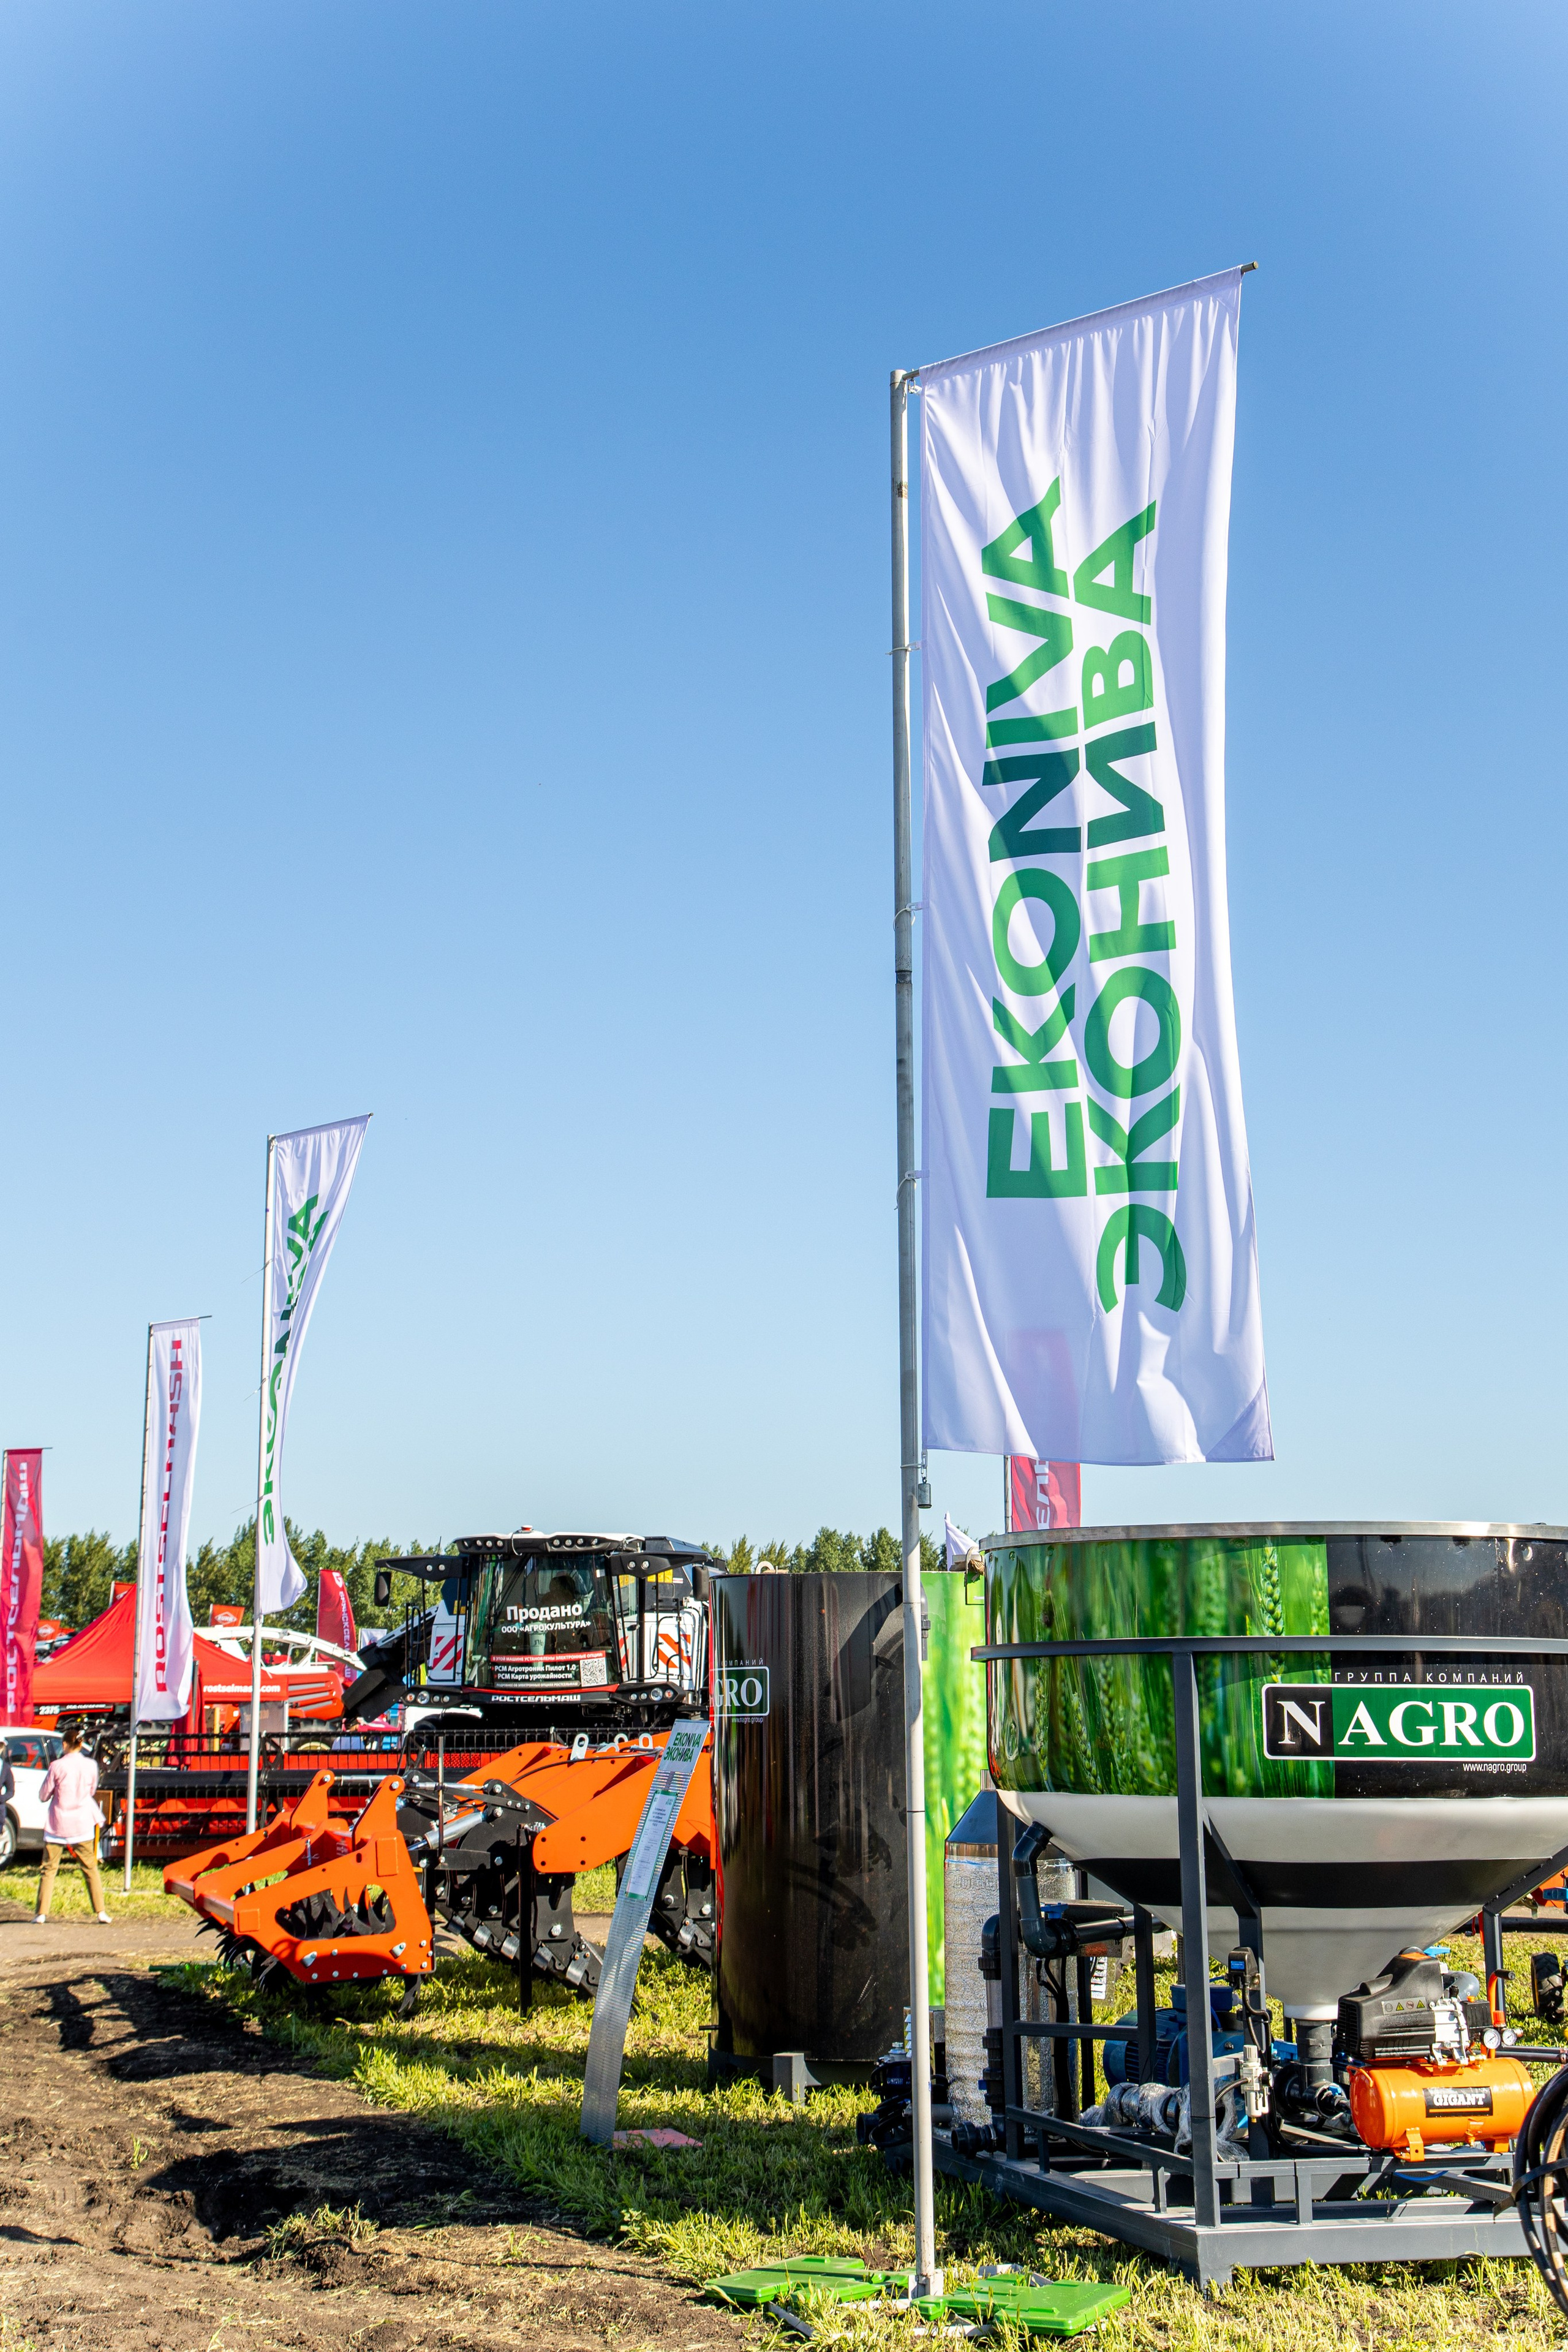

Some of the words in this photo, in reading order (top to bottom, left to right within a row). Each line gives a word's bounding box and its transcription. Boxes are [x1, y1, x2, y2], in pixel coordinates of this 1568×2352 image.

[981, 477, 1087, 1199] EKONIVA
[1074, 500, 1186, 1313] ЭКОНИВА
[156, 1340, 183, 1692] ROSTSELMASH
[6, 1461, 29, 1714] РОСТСЕЛЬМАШ
[507, 1604, 582, 1623] Продано
[519, 1619, 591, 1632] «АГРОКУЛЬТУРА»
[508, 1665, 545, 1673] Агротроник
[530, 1672, 573, 1681] урожайности
[1335, 1672, 1411, 1683] ГРУППА
[1426, 1672, 1523, 1683] КОМПАНИЙ
[203, 1683, 281, 1693] rostselmas.com
[673, 1732, 702, 1747] EKONIVA
[663, 1746, 694, 1762] ЭКОНИВА
[1463, 1763, 1527, 1774] www.nagro.group
[1433, 2094, 1485, 2106] GIGANT
